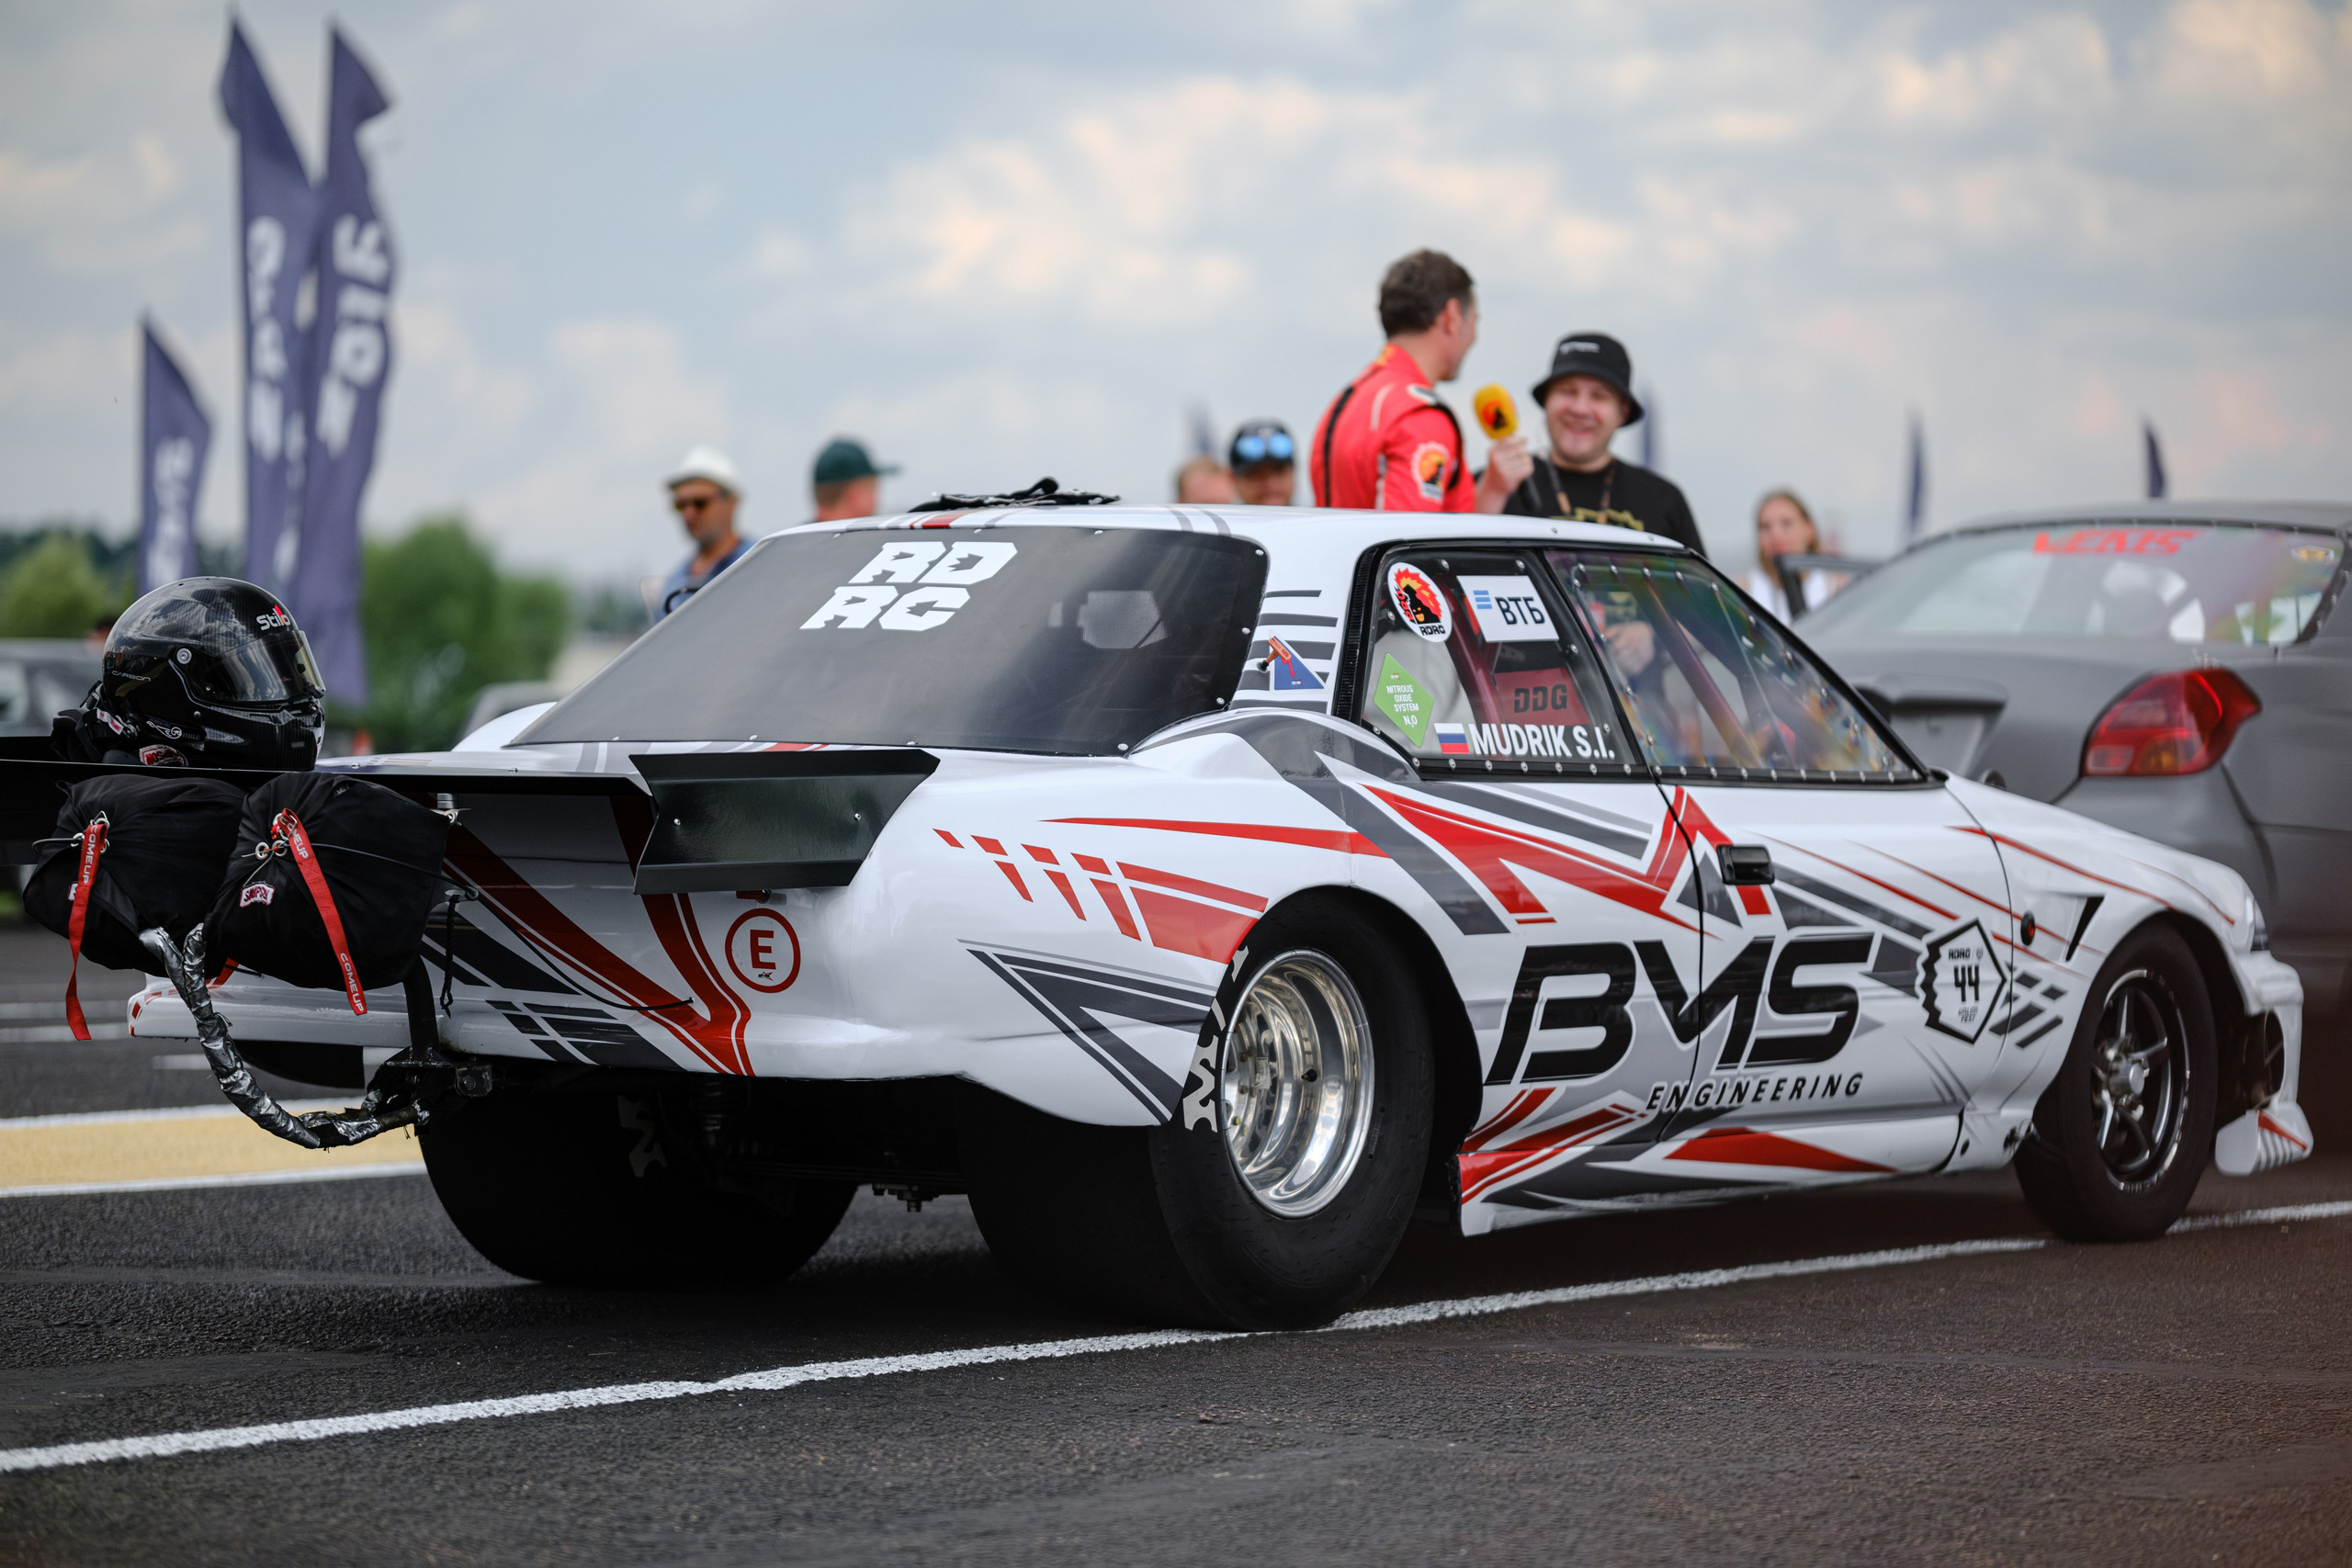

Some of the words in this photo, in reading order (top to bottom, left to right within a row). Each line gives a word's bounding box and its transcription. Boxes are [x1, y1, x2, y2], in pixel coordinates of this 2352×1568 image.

[847, 540, 1019, 585] RD
[256, 604, 291, 631] Stilo
[799, 585, 971, 632] RC
[1395, 588, 1416, 622] PRO
[1495, 597, 1545, 626] ВТБ
[1419, 626, 1446, 636] RDRC
[111, 670, 152, 682] CARBON
[1385, 684, 1414, 694] NITROUS
[1393, 703, 1419, 712] SYSTEM
[1394, 694, 1413, 703] OXIDE
[1468, 723, 1572, 758] MUDRIK
[1572, 726, 1615, 759] S.I.
[82, 825, 98, 885] COMEUP
[750, 929, 776, 970] E
[340, 953, 364, 1012] COMEUP
[1953, 964, 1980, 1002] 44
[1484, 931, 1875, 1087] BMS
[1645, 1072, 1864, 1111] ENGINEERING
